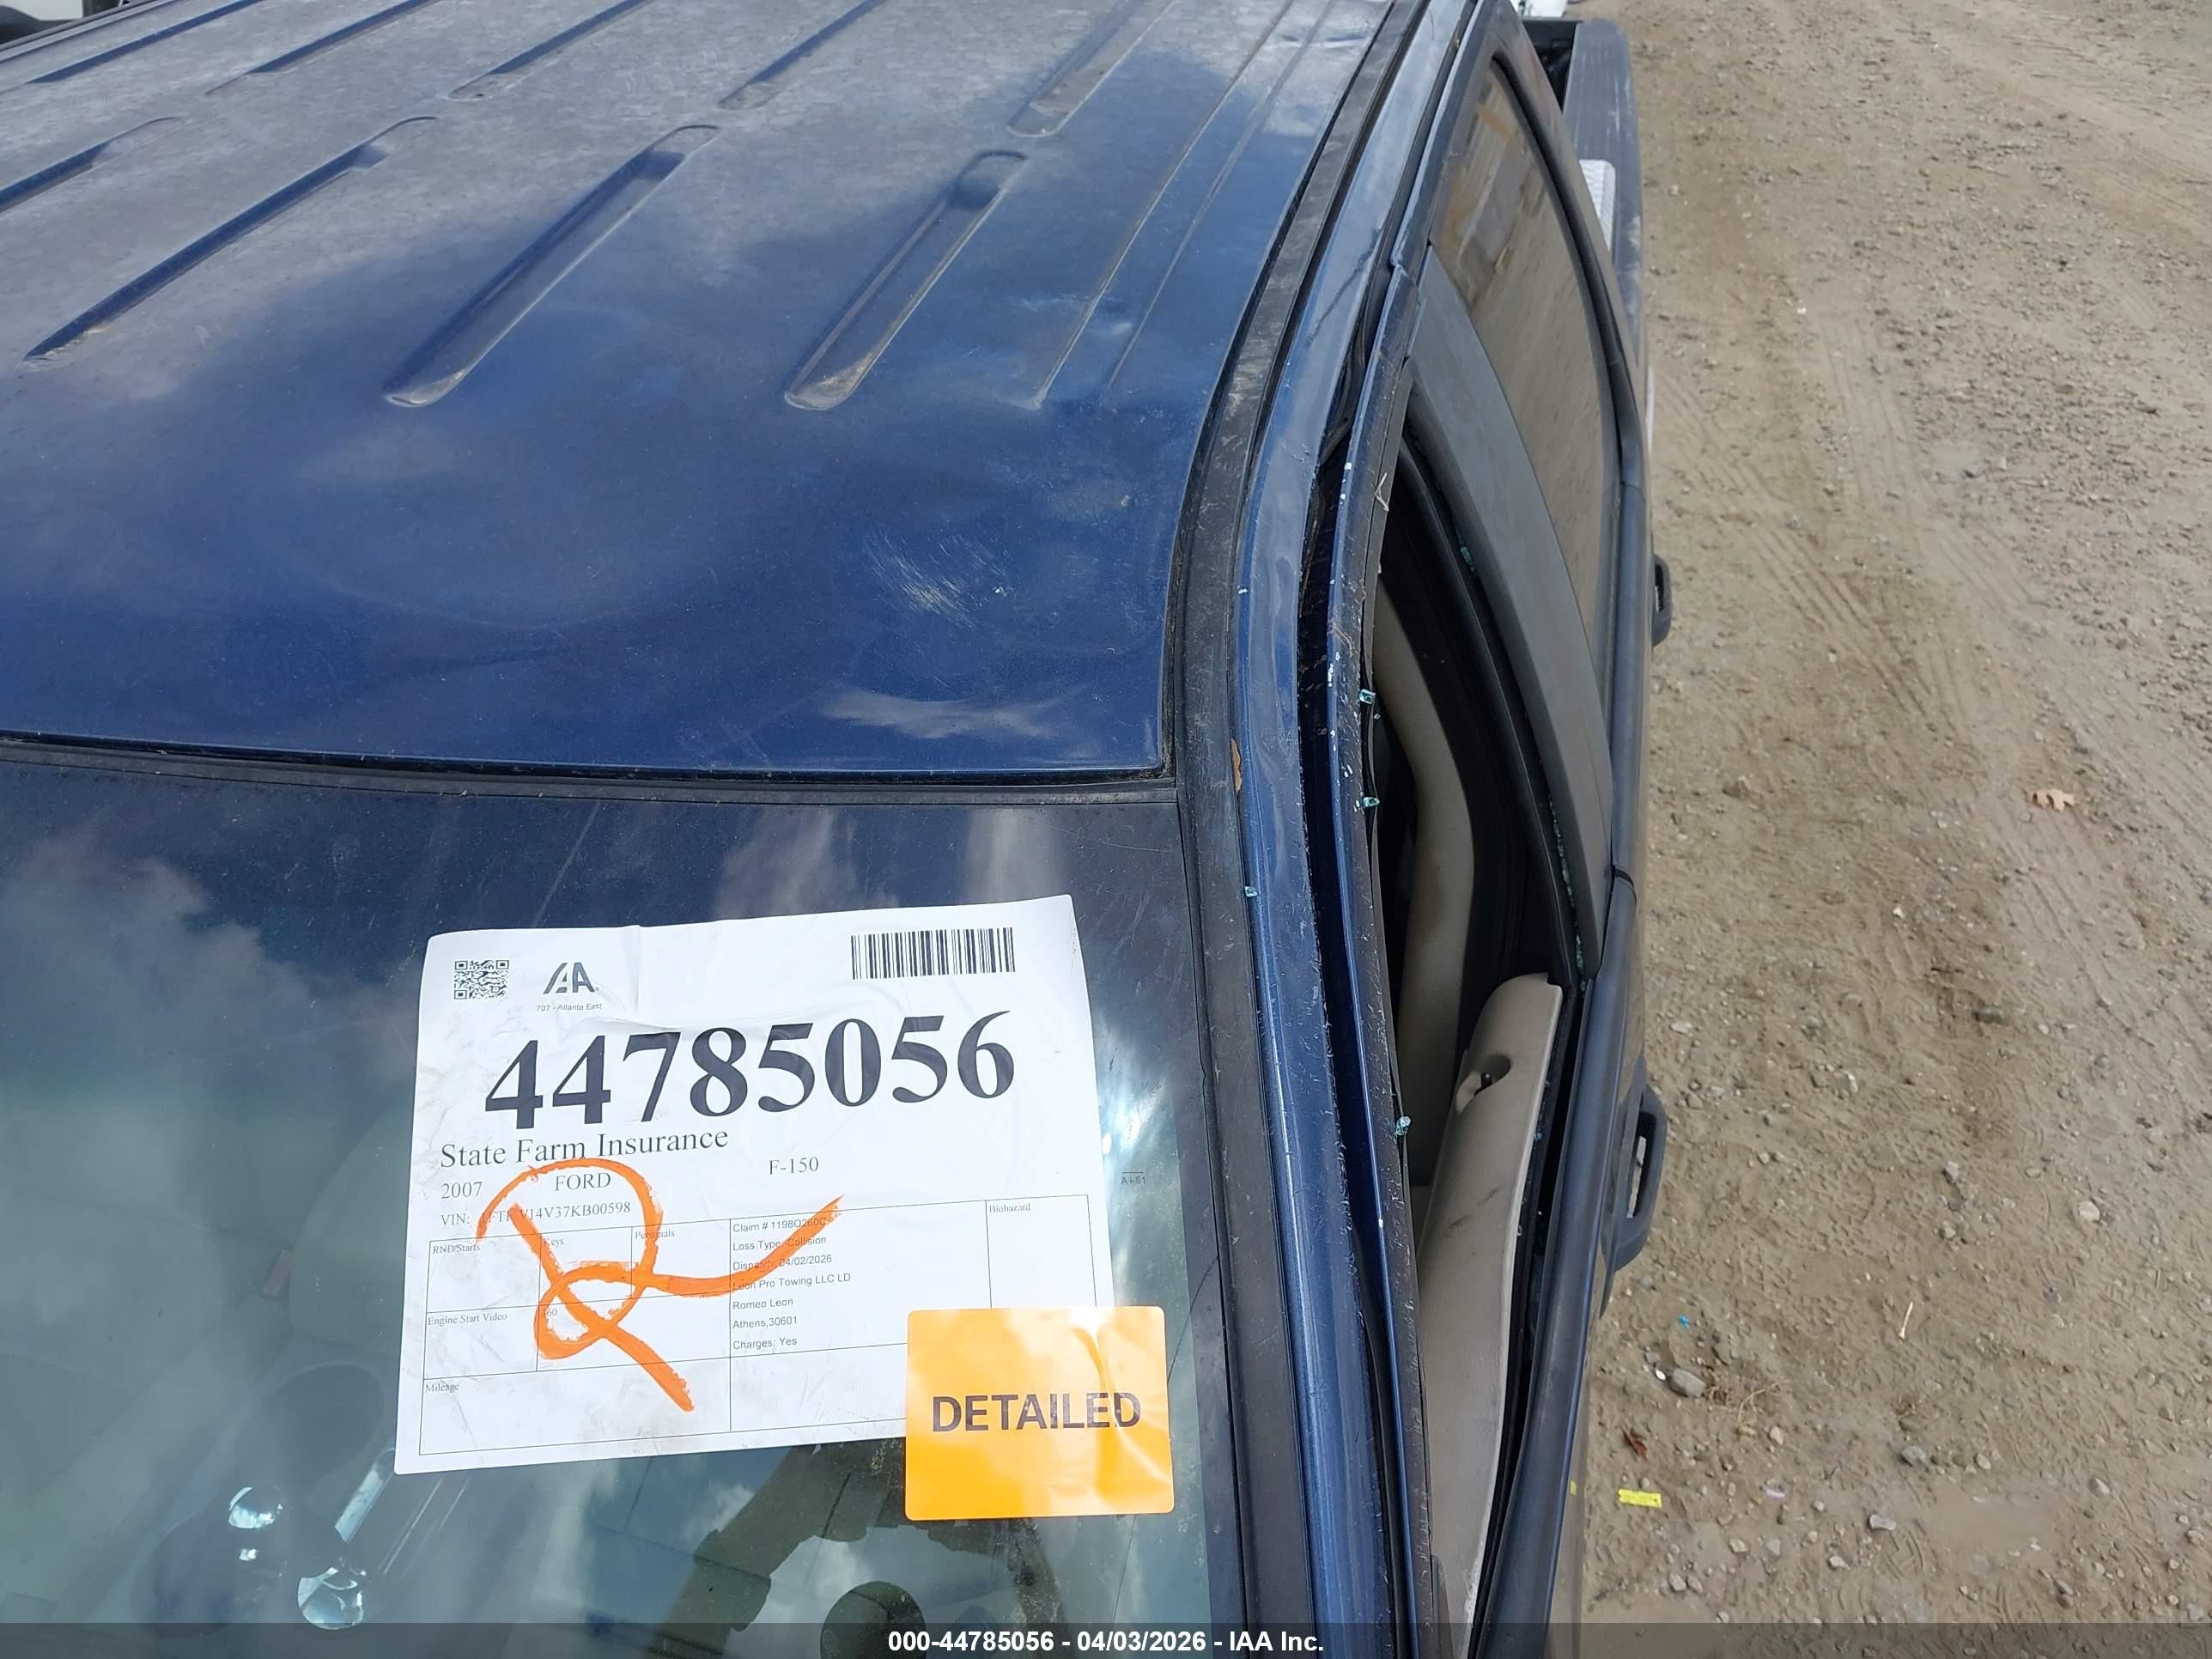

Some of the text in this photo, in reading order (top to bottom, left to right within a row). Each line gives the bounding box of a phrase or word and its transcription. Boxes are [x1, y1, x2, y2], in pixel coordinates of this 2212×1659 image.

[557, 1003, 584, 1012] Atlanta
[586, 1002, 603, 1011] East
[485, 1011, 1014, 1130] 44785056
[441, 1130, 729, 1168] State Farm Insurance
[441, 1157, 819, 1200] 2007 FORD F-150
[989, 1202, 1031, 1214] Biohazard
[441, 1213, 471, 1226] VIN:
[732, 1223, 760, 1232] Claim
[762, 1222, 769, 1231] #
[433, 1243, 481, 1255] RND/Starts
[543, 1238, 564, 1248] Keys
[732, 1242, 755, 1251] Loss
[787, 1236, 827, 1248] Collision
[779, 1254, 832, 1267] 04/02/2026
[759, 1279, 775, 1288] Pro
[779, 1276, 812, 1287] Towing
[816, 1273, 835, 1284] LLC
[838, 1273, 851, 1282] LD
[732, 1297, 793, 1310] Romeo Leon
[428, 1312, 507, 1328] Engine Start Video
[732, 1316, 798, 1329] Athens,30601
[732, 1337, 798, 1351] Charges: Yes
[425, 1382, 460, 1393] Mileage
[932, 1392, 1142, 1433] DETAILED
